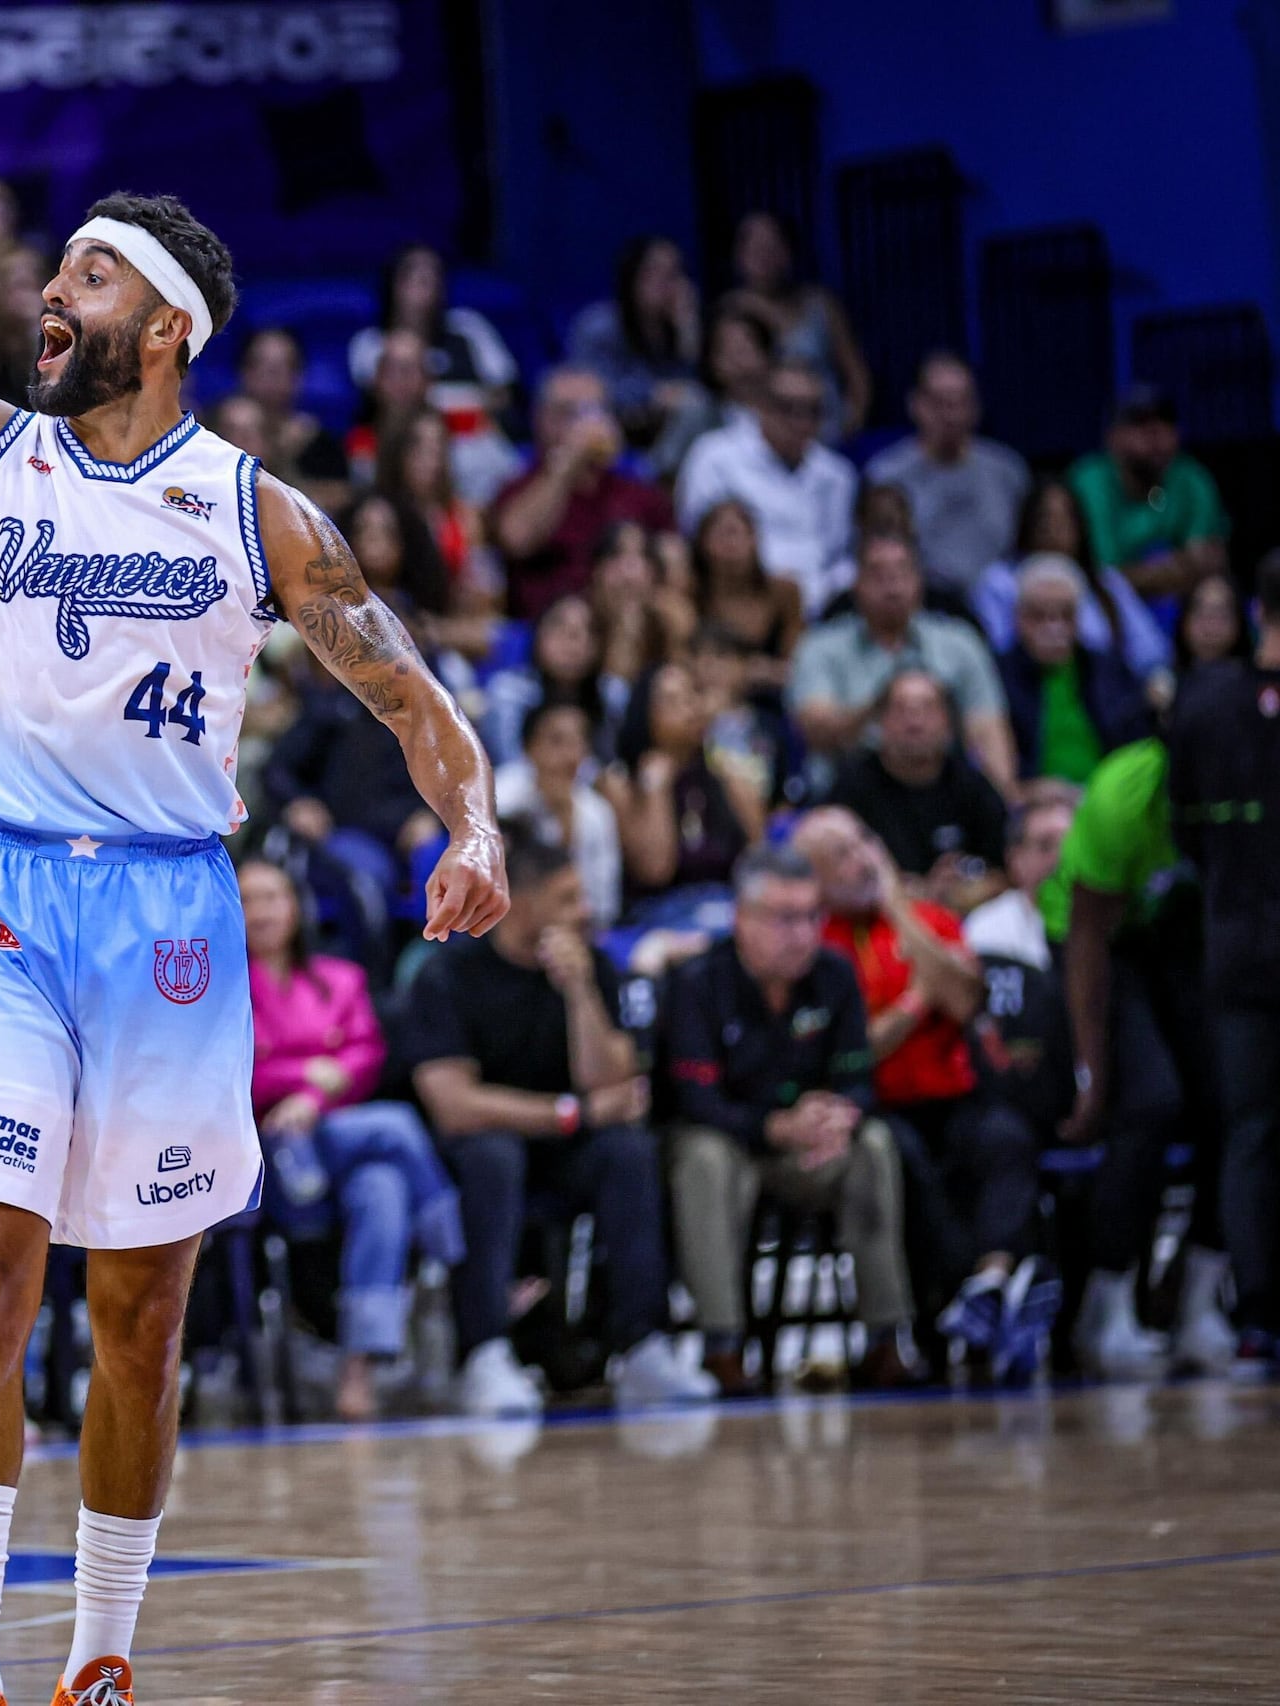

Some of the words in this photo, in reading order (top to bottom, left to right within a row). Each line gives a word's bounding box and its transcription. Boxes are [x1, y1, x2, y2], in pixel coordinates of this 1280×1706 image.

[123, 661, 207, 747] 44
[173, 955, 194, 990] 17
[136, 1168, 216, 1205] Liberty
